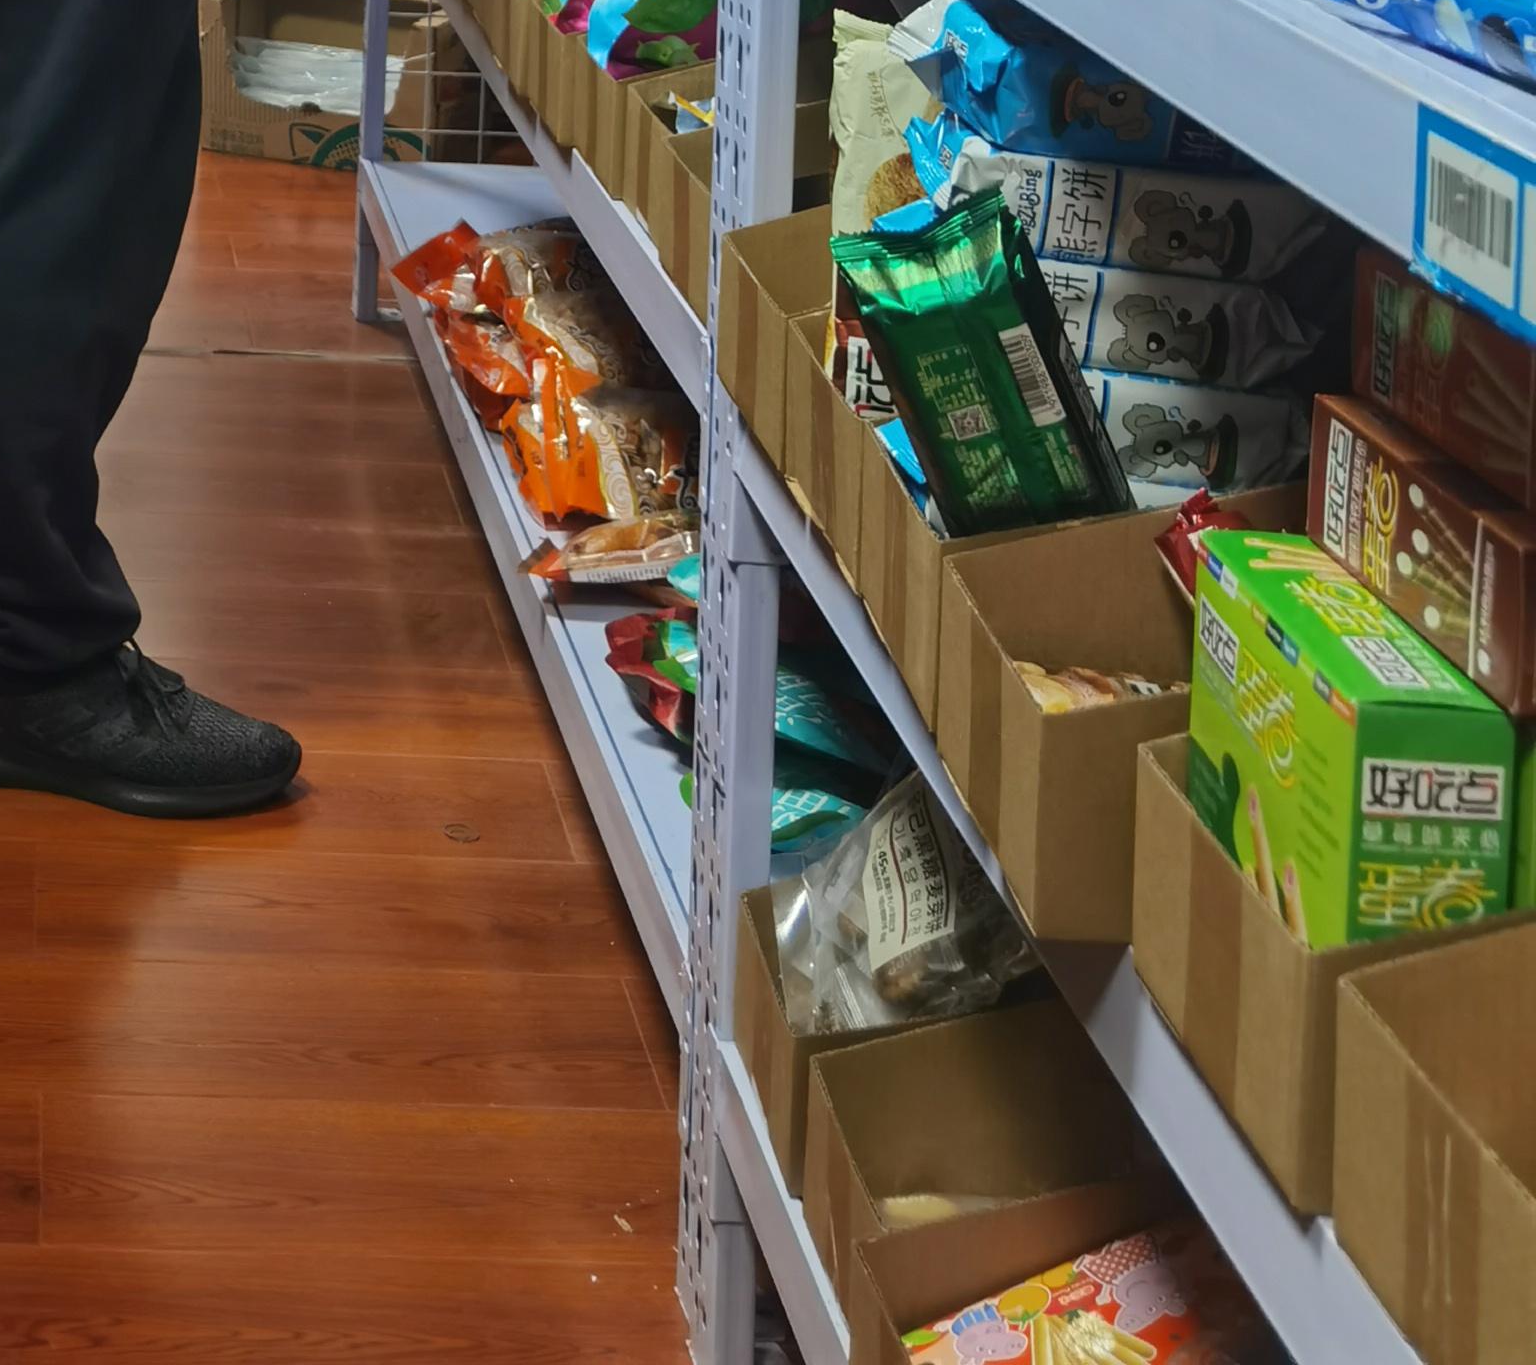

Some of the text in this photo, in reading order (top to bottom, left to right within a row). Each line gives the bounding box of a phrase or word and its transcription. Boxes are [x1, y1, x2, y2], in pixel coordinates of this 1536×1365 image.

[1016, 168, 1043, 239] ngZiBing
[1324, 424, 1351, 555] 好吃点
[1201, 598, 1237, 680] 好吃点
[1369, 763, 1499, 814] 好吃点
